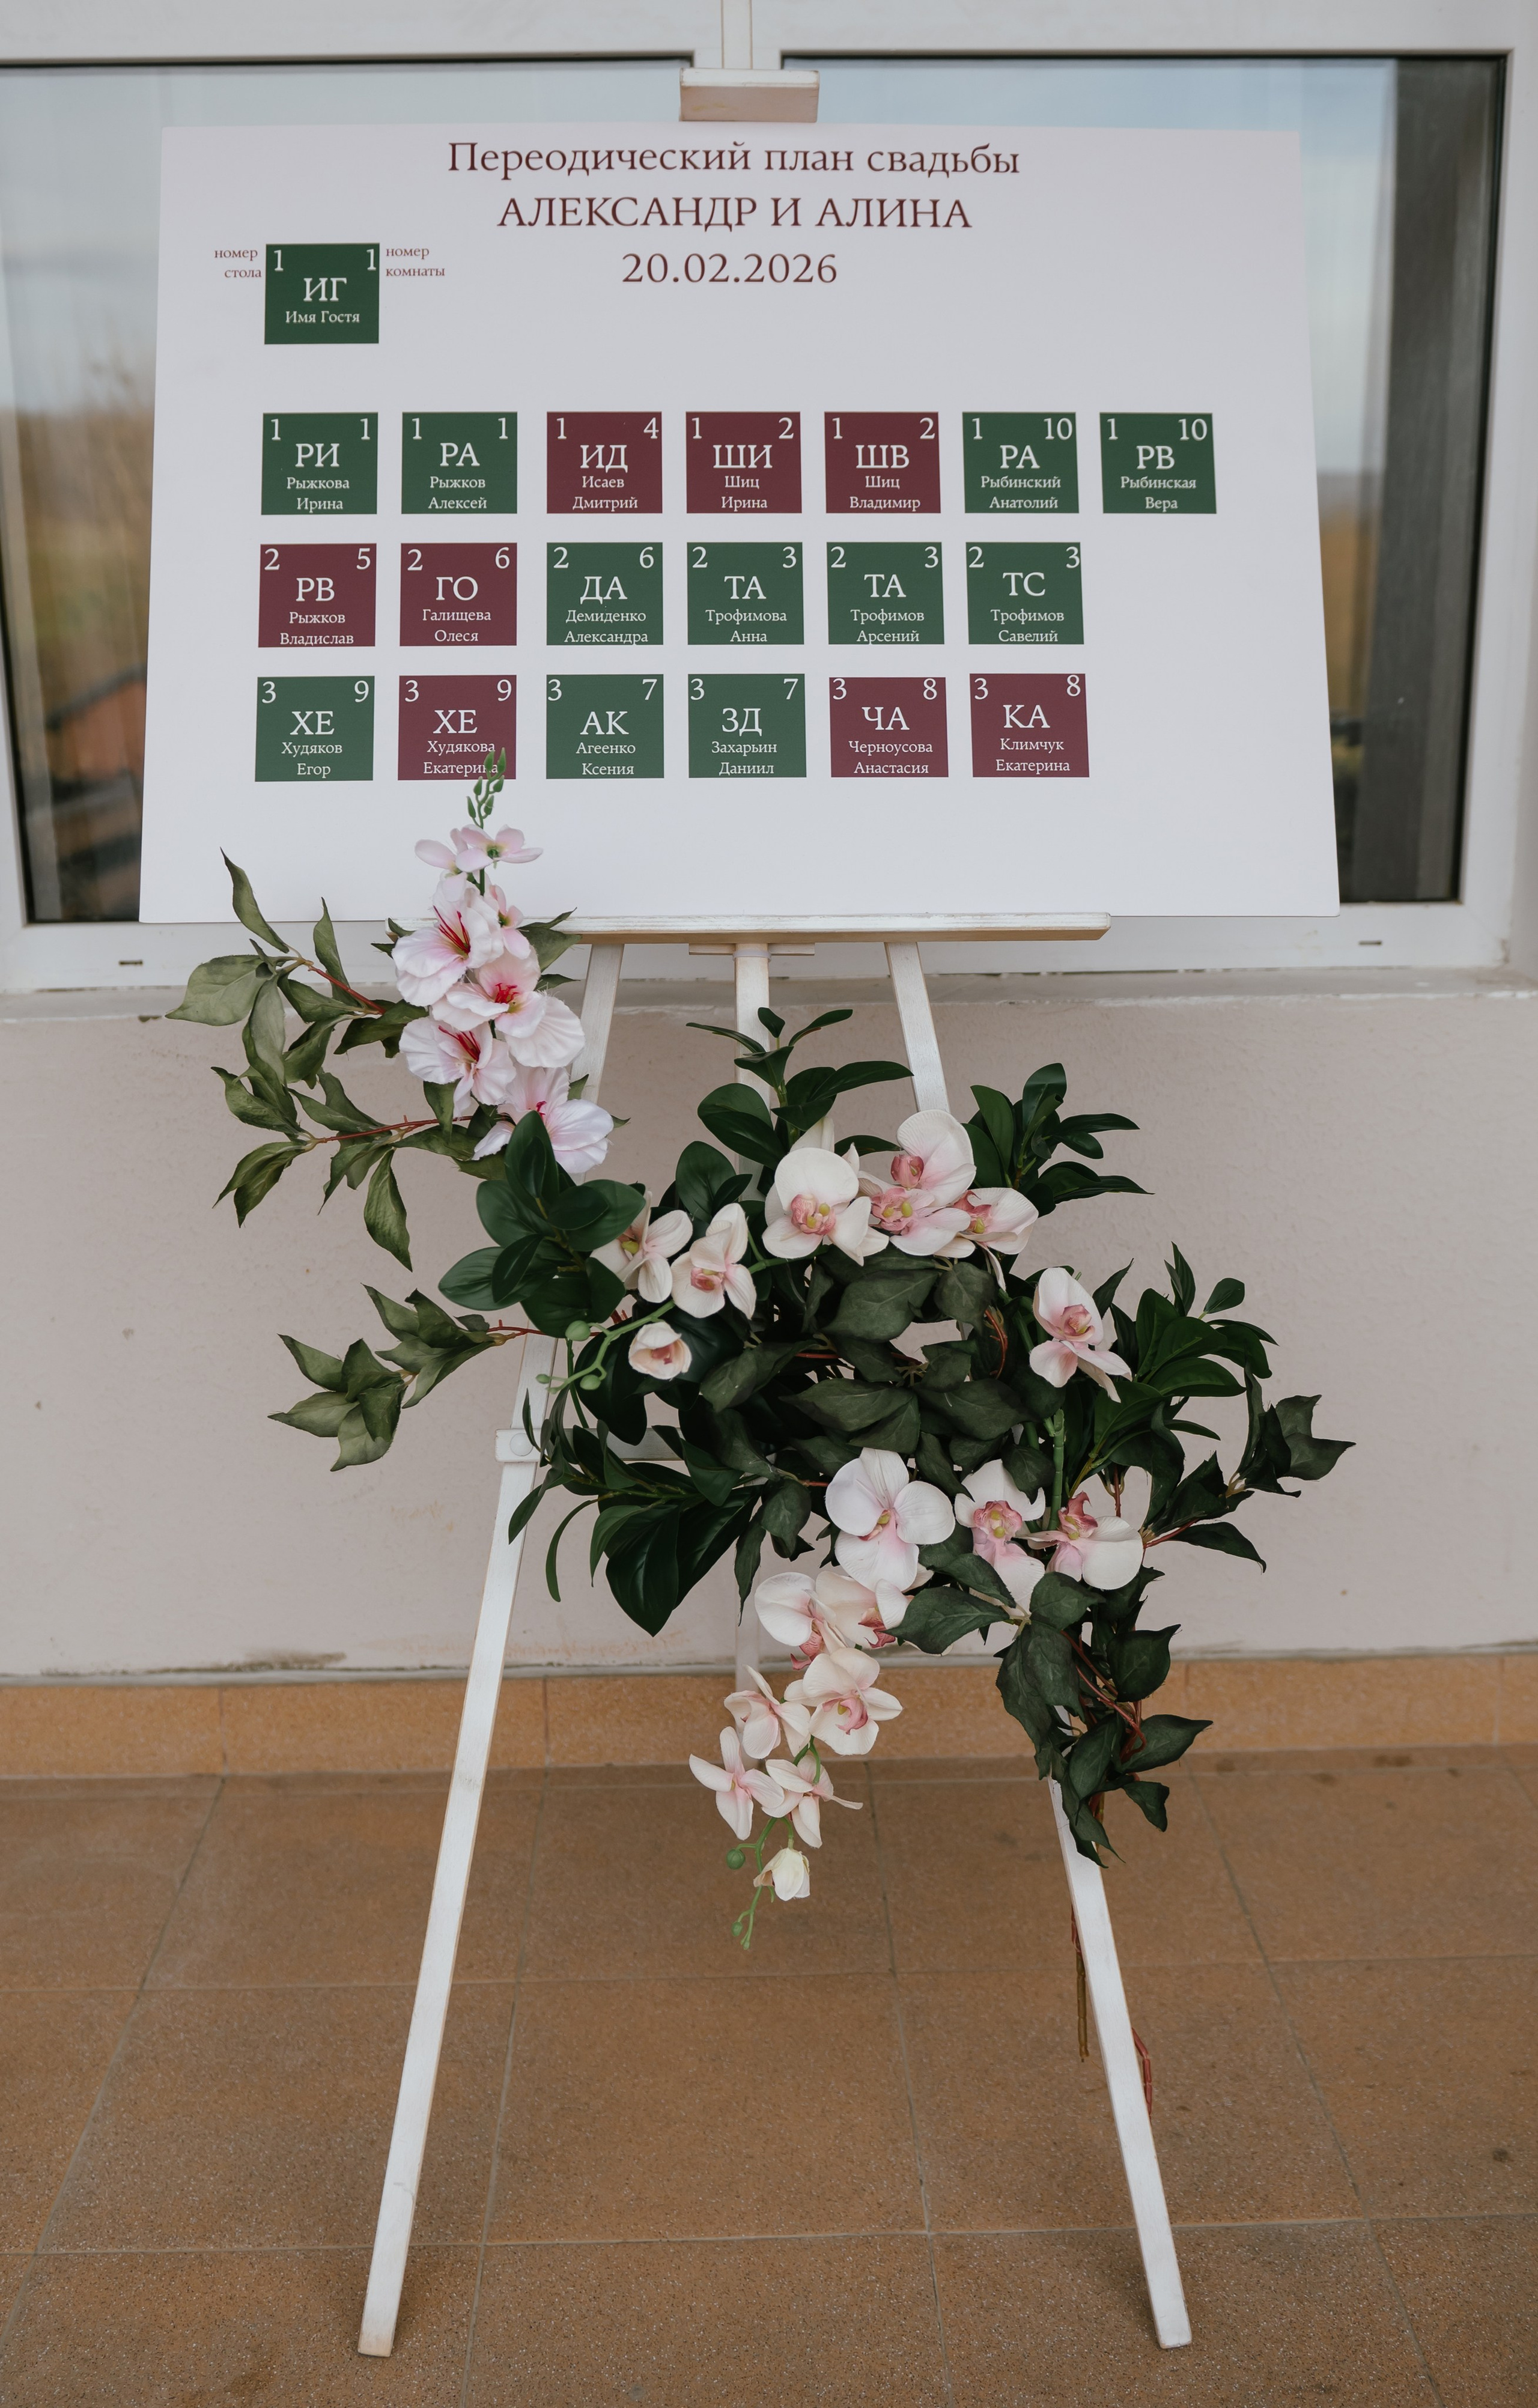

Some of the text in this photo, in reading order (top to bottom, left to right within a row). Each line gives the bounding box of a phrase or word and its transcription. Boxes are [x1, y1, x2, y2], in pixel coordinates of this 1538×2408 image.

[449, 142, 1019, 180] Переодический план свадьбы
[497, 197, 971, 232] АЛЕКСАНДР И АЛИНА
[215, 251, 258, 261] номер
[275, 250, 283, 271] 1
[367, 249, 376, 270] 1
[386, 249, 429, 259] номер
[623, 254, 836, 282] 20.02.2026
[303, 278, 347, 301] ИГ
[286, 311, 359, 323] Имя Гостя
[272, 419, 281, 440] 1
[360, 419, 370, 440] 1
[412, 418, 422, 439] 1
[499, 418, 508, 439] 1
[557, 418, 567, 439] 1
[644, 418, 658, 439] 4
[692, 418, 702, 439] 1
[779, 418, 794, 439] 2
[833, 418, 842, 439] 1
[920, 418, 935, 439] 2
[973, 418, 982, 439] 1
[1044, 418, 1072, 440] 10
[1108, 419, 1118, 440] 1
[1179, 419, 1207, 440] 10
[296, 443, 339, 467] РИ
[440, 443, 479, 466] РА
[580, 445, 628, 473] ИД
[713, 445, 772, 468] ШИ
[856, 445, 909, 468] ШВ
[1000, 445, 1040, 468] РА
[1137, 446, 1175, 469] РВ
[287, 477, 349, 489] Рыжкова
[430, 476, 485, 488] Рыжков
[583, 476, 624, 487] Исаев
[725, 476, 759, 489] Шиц
[866, 476, 899, 488] Шиц
[981, 476, 1060, 487] Рыбинский
[1121, 476, 1196, 488] Рыбинская
[297, 498, 344, 513] Ирина
[428, 497, 487, 508] Алексей
[572, 497, 639, 512] Дмитрий
[721, 497, 768, 512] Ирина
[850, 497, 922, 512] Владимир
[989, 497, 1058, 508] Анатолий
[1144, 497, 1178, 512] Вера
[264, 549, 279, 570] 2
[357, 548, 370, 570] 5
[408, 549, 422, 570] 2
[496, 547, 509, 568] 6
[554, 547, 568, 568] 2
[640, 547, 654, 568] 6
[693, 547, 707, 568] 2
[783, 547, 796, 568] 3
[831, 547, 846, 567] 2
[925, 547, 938, 568] 3
[968, 547, 983, 568] 2
[1066, 546, 1080, 568] 3
[296, 578, 334, 601] РВ
[436, 577, 478, 600] ГО
[580, 577, 627, 604] ДА
[725, 576, 766, 599] ТА
[865, 574, 906, 597] ТА
[1003, 573, 1045, 596] ТС
[290, 612, 345, 623] Рыжков
[423, 609, 491, 622] Галищева
[566, 610, 646, 623] Демиденко
[705, 609, 787, 624] Трофимова
[851, 609, 924, 624] Трофимов
[991, 609, 1064, 624] Трофимов
[280, 633, 354, 646] Владислав
[435, 630, 478, 641] Олеся
[564, 631, 649, 645] Александра
[730, 631, 767, 642] Анна
[856, 630, 920, 644] Арсений
[998, 630, 1059, 643] Савелий
[262, 681, 276, 703] 3
[354, 681, 369, 702] 9
[405, 680, 419, 702] 3
[497, 680, 511, 701] 9
[547, 678, 562, 701] 3
[643, 679, 657, 700] 7
[690, 678, 704, 701] 3
[784, 679, 798, 699] 7
[832, 678, 848, 699] 3
[923, 678, 938, 699] 8
[975, 678, 988, 699] 3
[1066, 674, 1081, 696] 8
[290, 711, 334, 735] ХЕ
[433, 710, 477, 733] ХЕ
[580, 711, 629, 734] АК
[722, 708, 762, 736] ЗД
[862, 707, 910, 730] ЧА
[1003, 705, 1050, 728] КА
[282, 743, 342, 757] Худяков
[427, 741, 495, 756] Худякова
[576, 743, 636, 753] Агеенко
[712, 741, 777, 756] Захарьин
[849, 741, 932, 756] Черноусова
[1000, 738, 1064, 753] Климчук
[297, 764, 330, 778] Егор
[582, 764, 634, 774] Ксения
[719, 762, 774, 776] Даниил
[854, 762, 928, 773] Анастасия
[996, 759, 1070, 774] Екатерина
